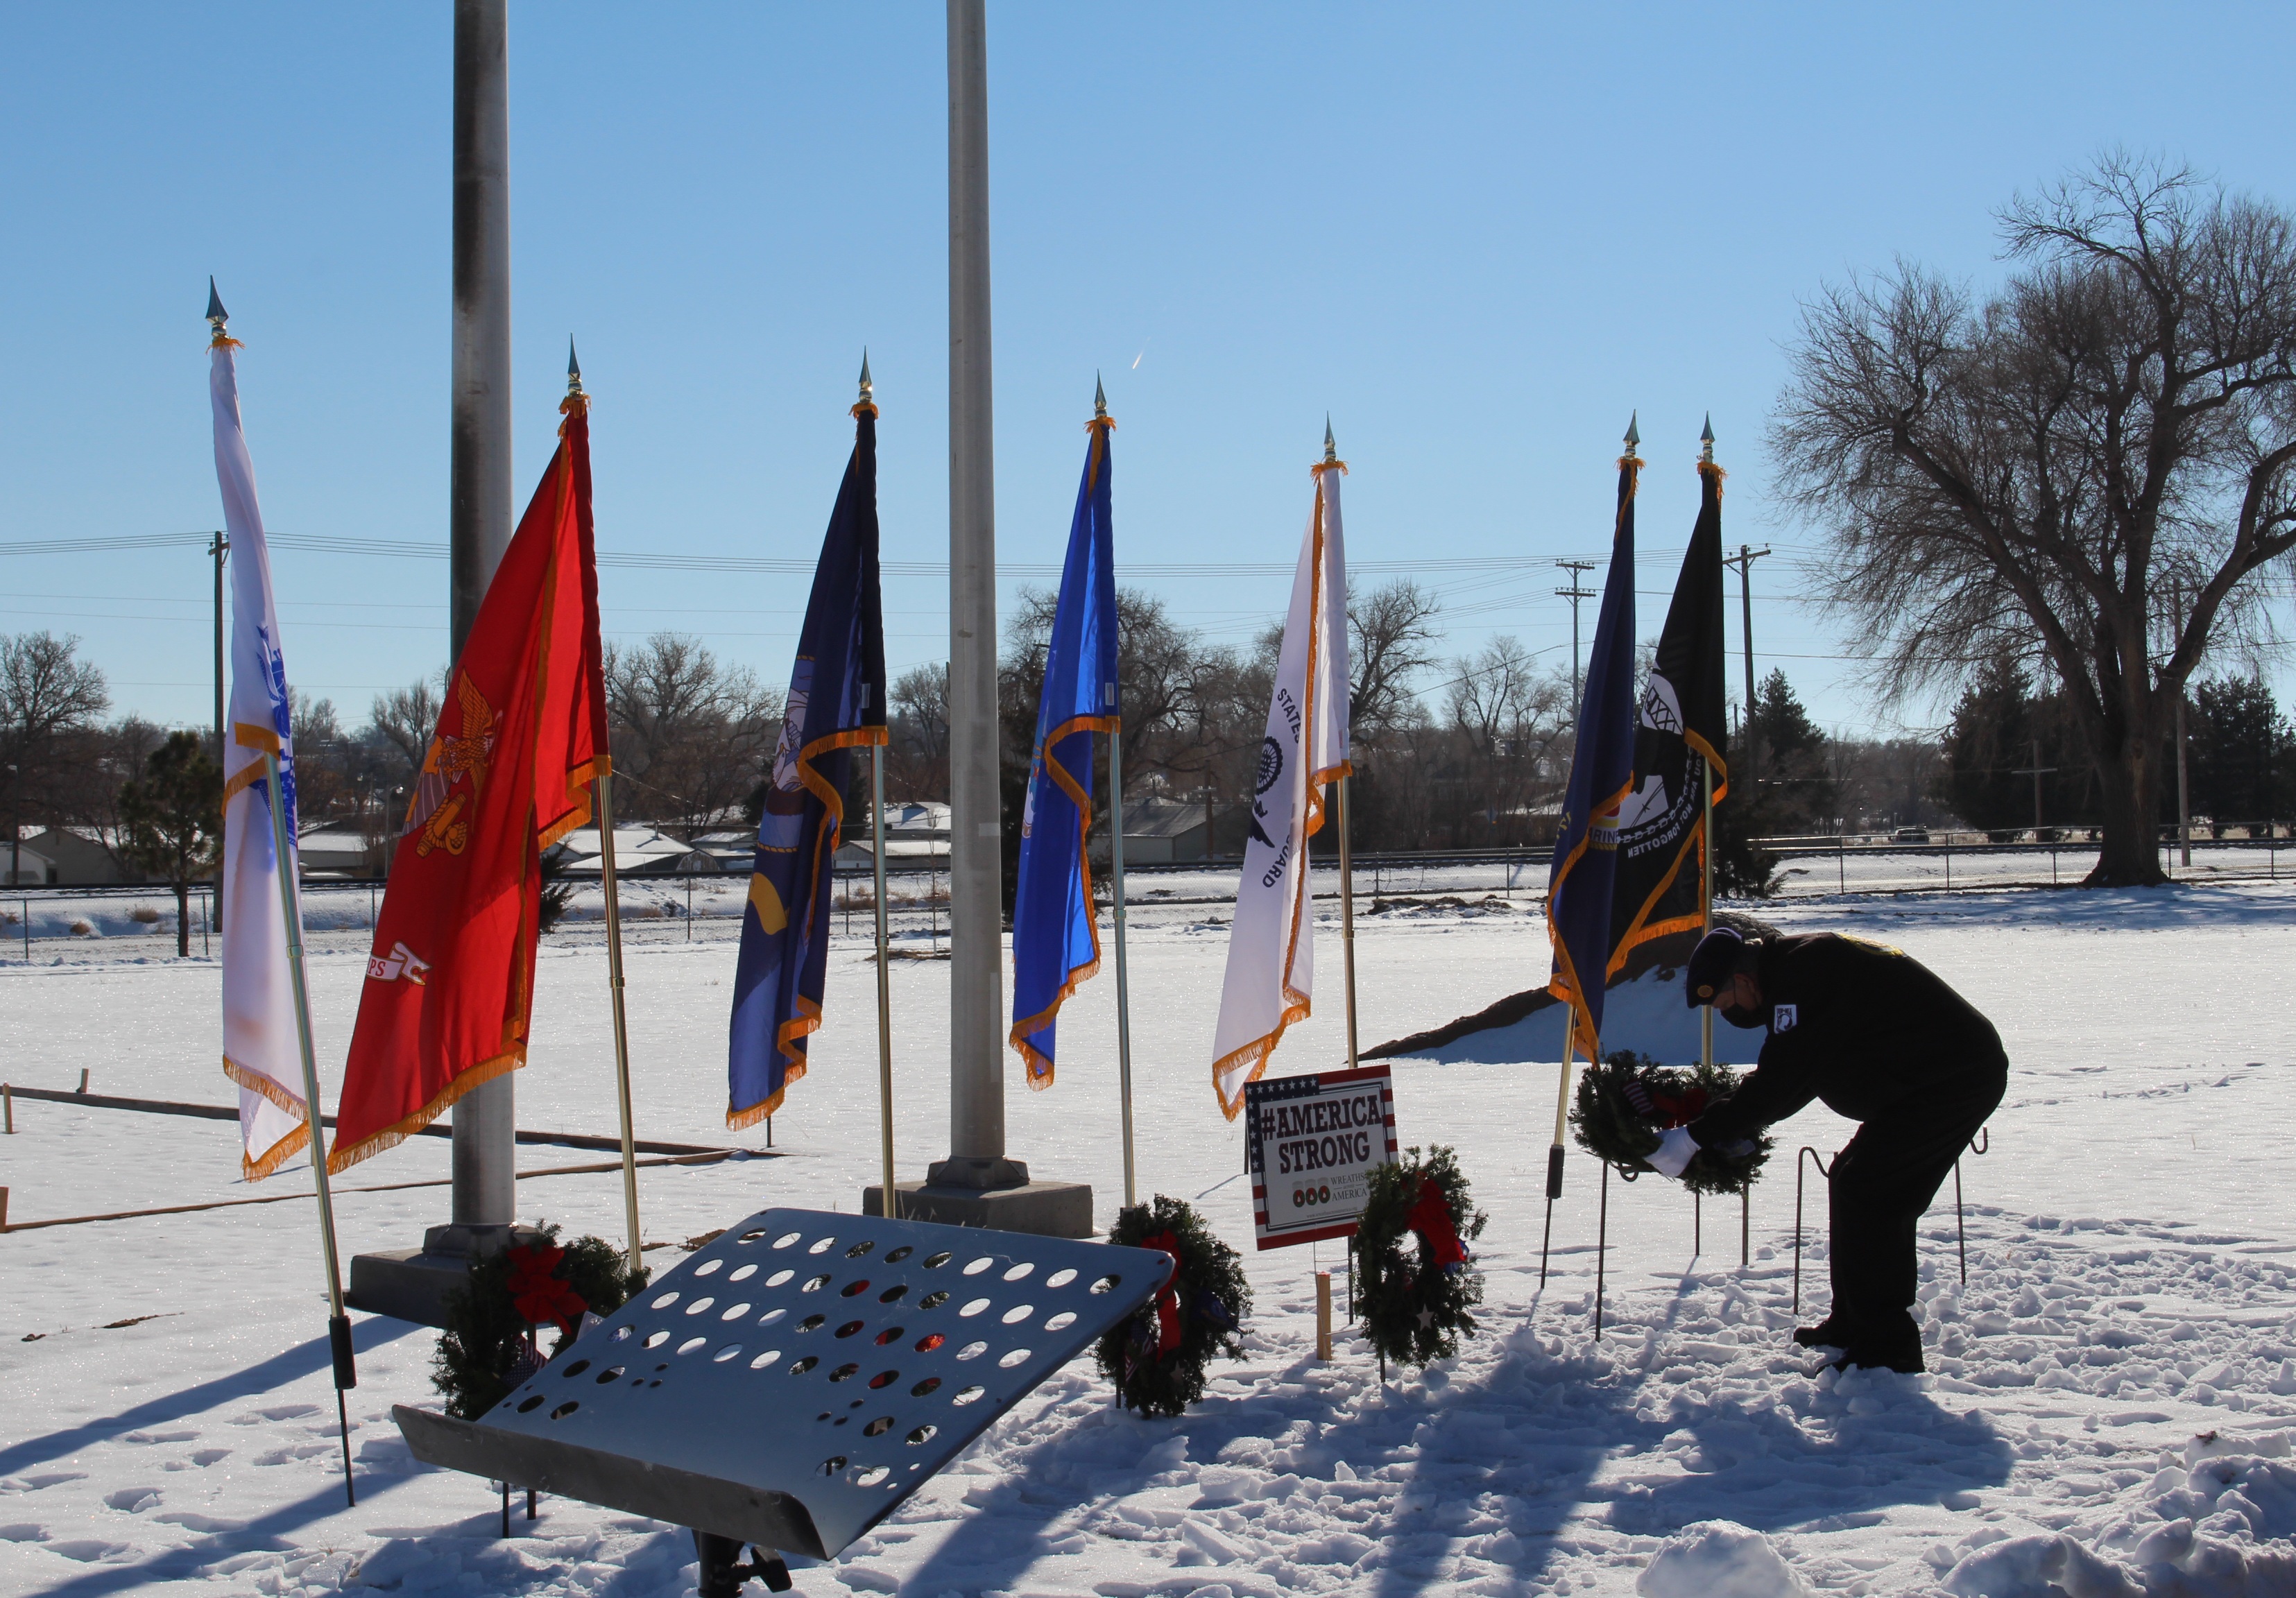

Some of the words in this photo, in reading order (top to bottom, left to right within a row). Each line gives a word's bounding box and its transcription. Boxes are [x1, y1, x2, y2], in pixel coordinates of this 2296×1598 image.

[1277, 688, 1301, 744] STATES
[1262, 834, 1290, 888] UARD
[1261, 1094, 1382, 1141] #AMERICA
[1278, 1131, 1370, 1174] STRONG
[1330, 1172, 1365, 1185] WREATHS
[1332, 1187, 1367, 1202] AMERICA
